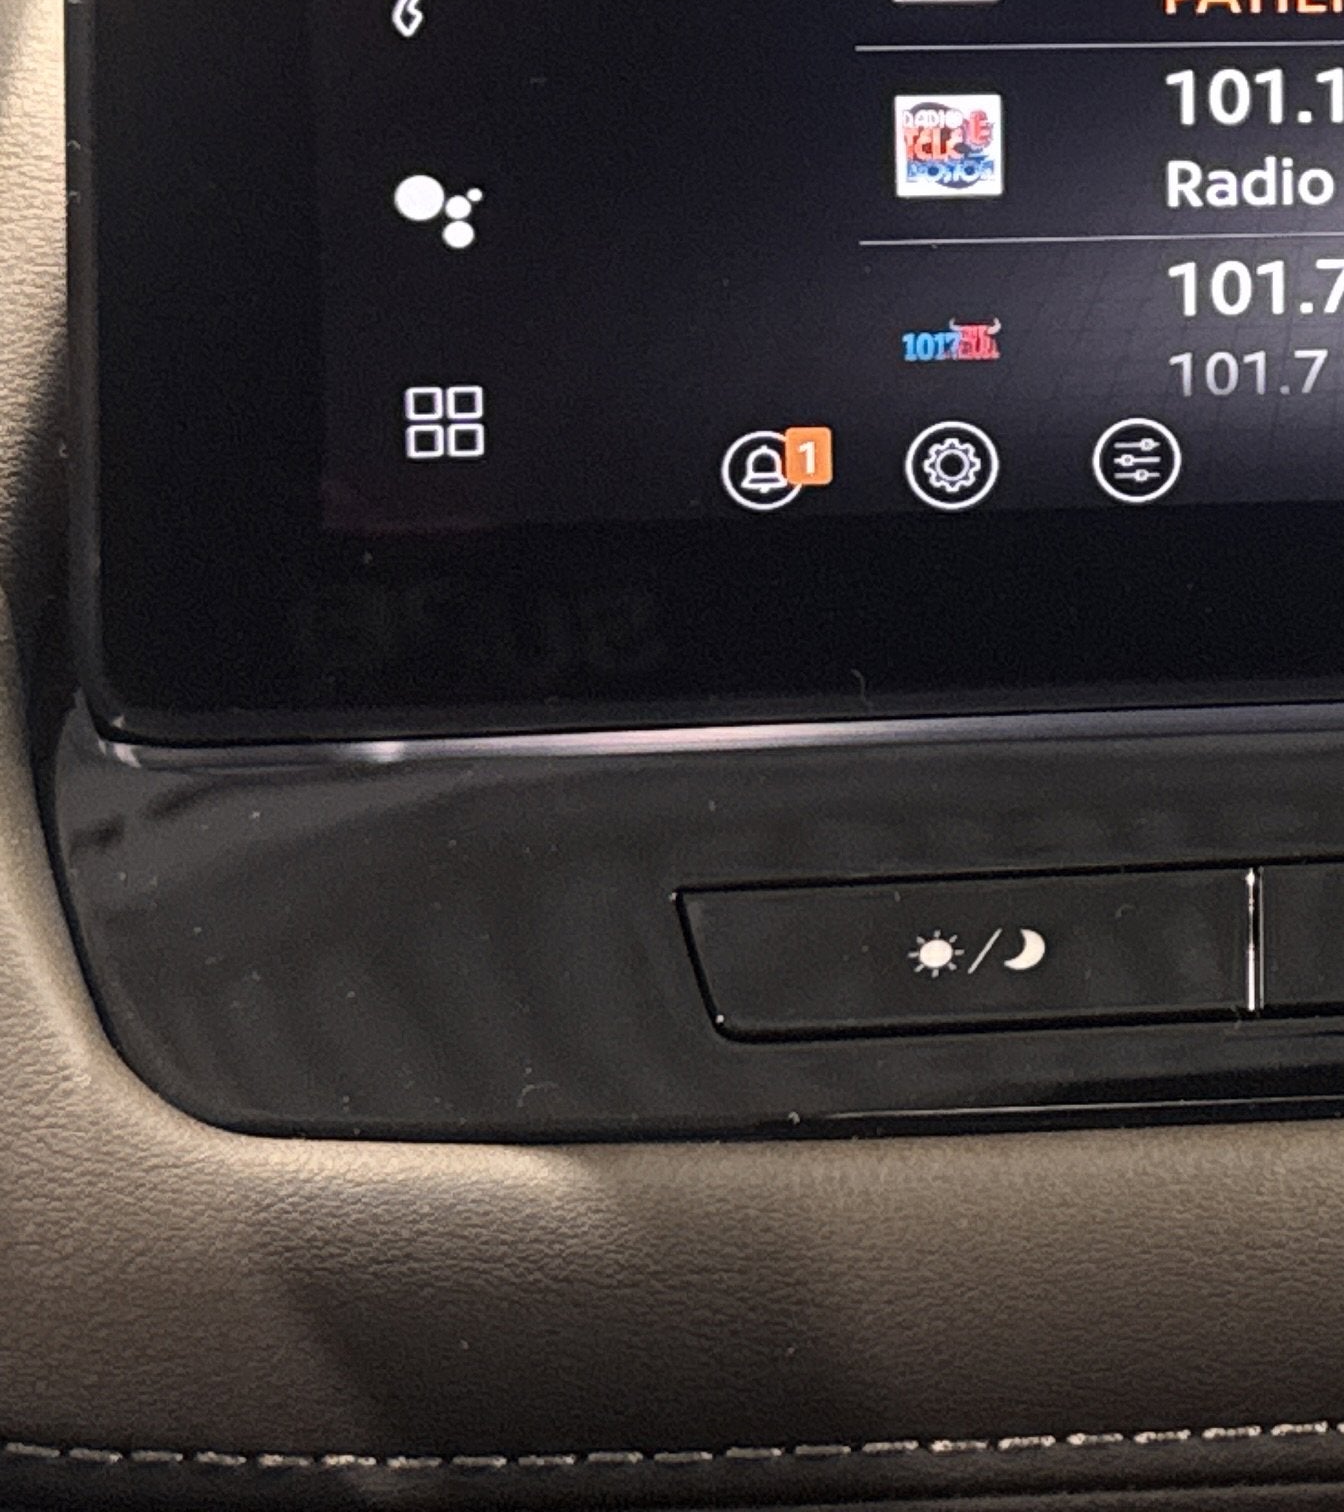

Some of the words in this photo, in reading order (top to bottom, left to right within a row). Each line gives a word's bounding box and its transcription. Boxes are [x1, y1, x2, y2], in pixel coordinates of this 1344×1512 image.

[1166, 68, 1344, 125] 101.1
[1168, 156, 1334, 207] Radio
[1168, 349, 1328, 397] 101.7
[797, 441, 818, 476] 1
